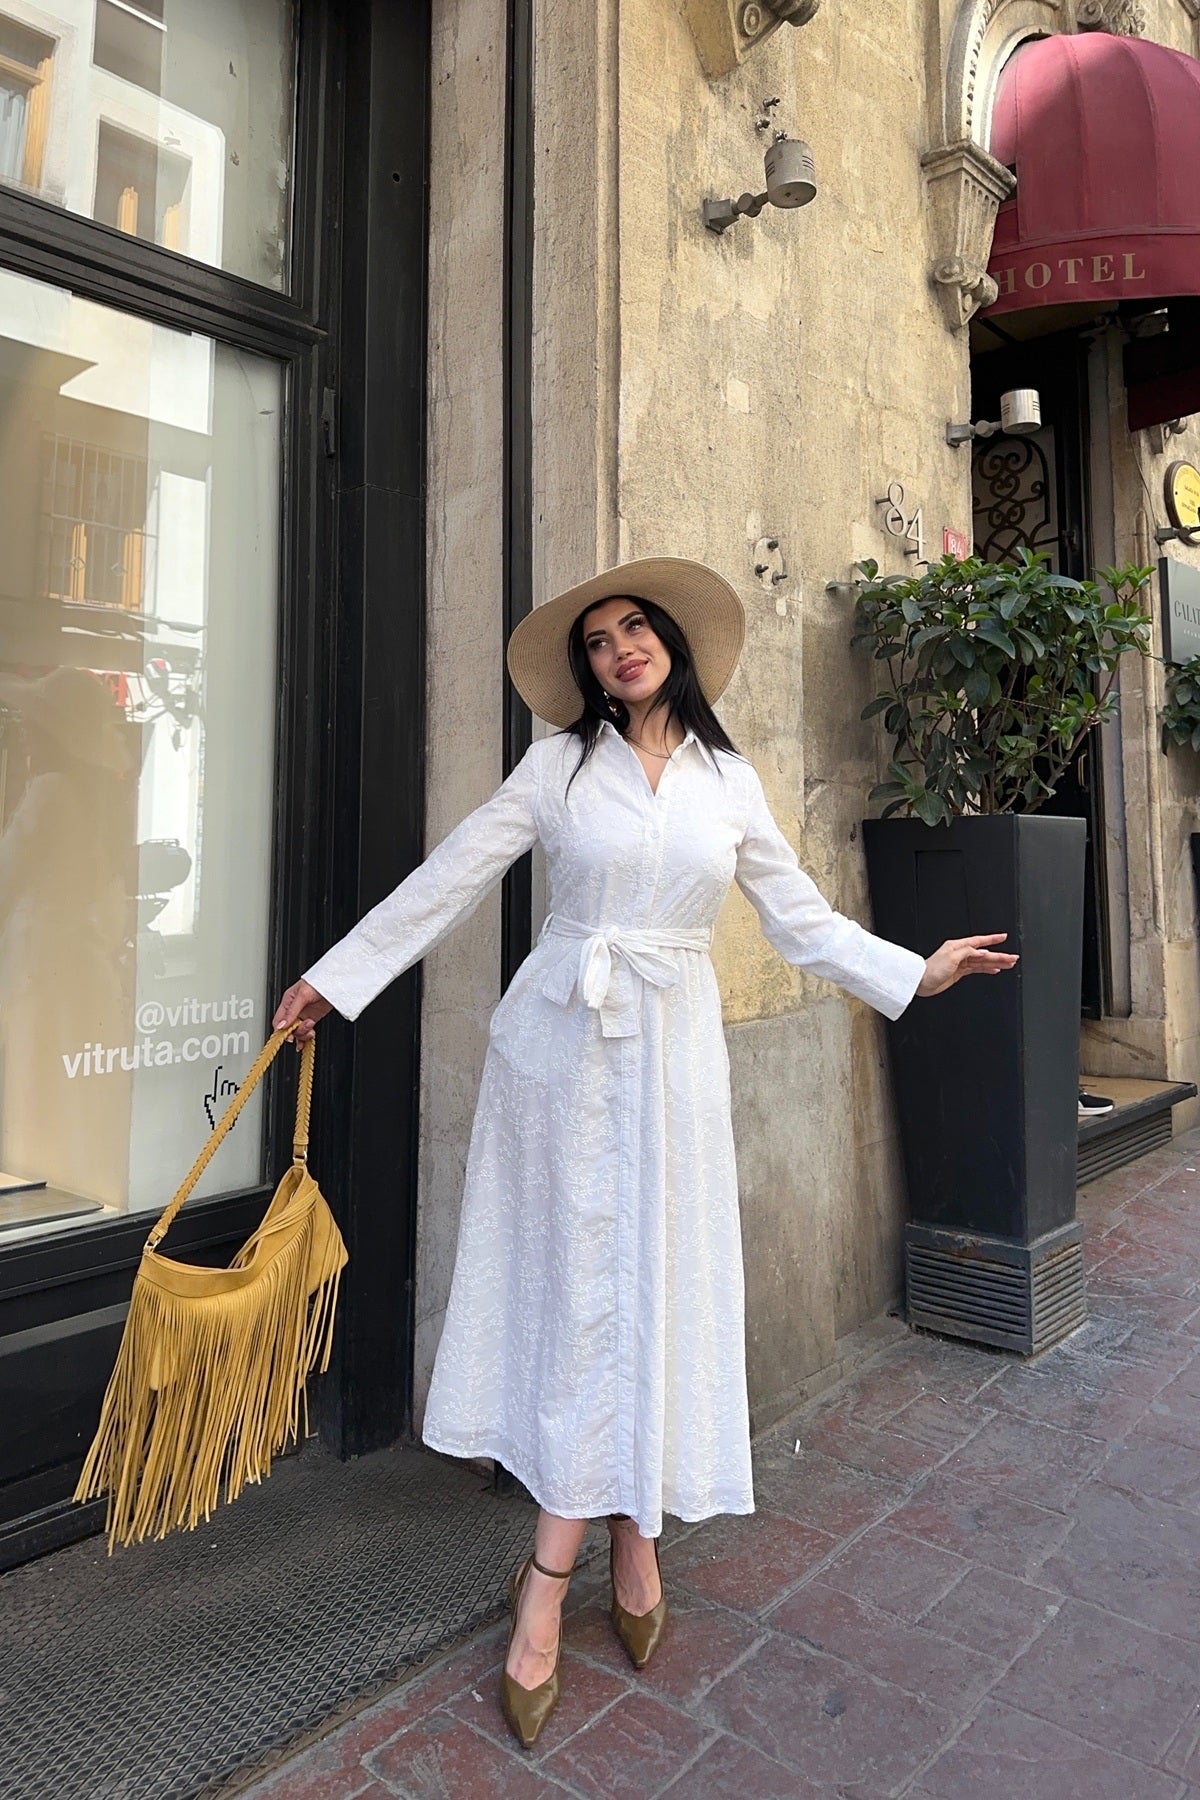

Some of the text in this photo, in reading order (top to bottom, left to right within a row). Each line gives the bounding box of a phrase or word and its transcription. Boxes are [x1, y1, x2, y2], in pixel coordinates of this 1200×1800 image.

[991, 253, 1146, 296] HOTEL
[885, 481, 926, 560] 84
[950, 537, 963, 557] 84
[136, 994, 254, 1034] @vitruta
[62, 1028, 250, 1079] vitruta.com
